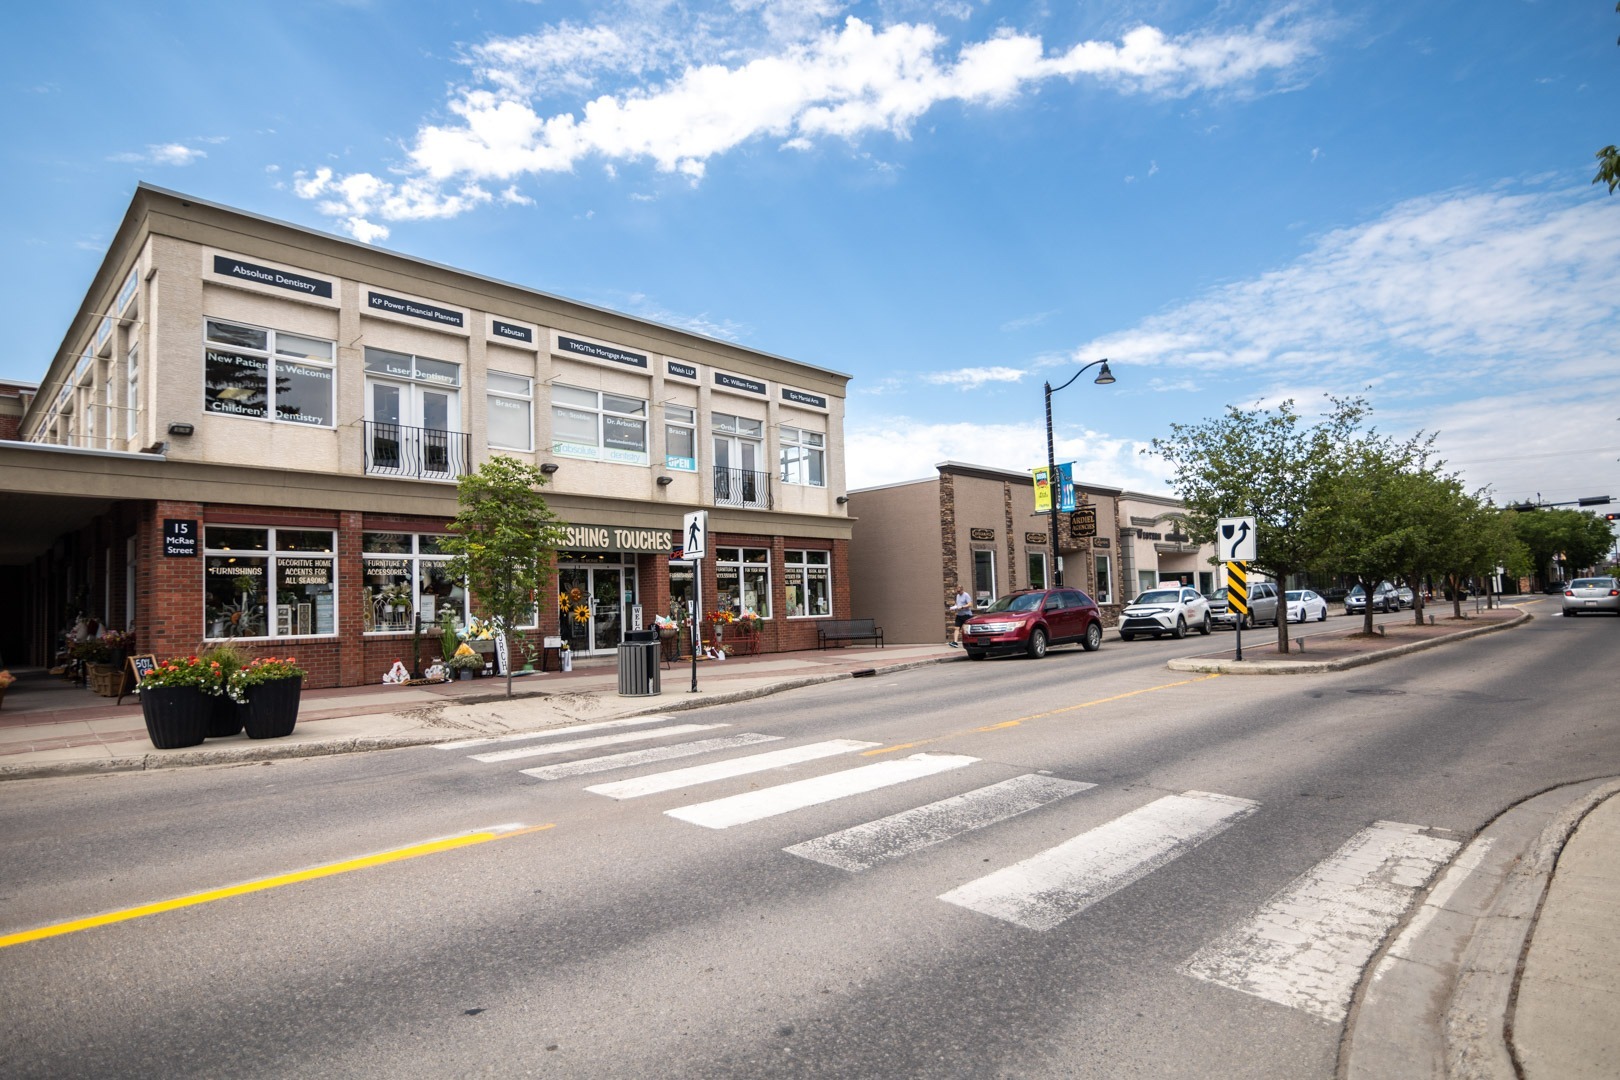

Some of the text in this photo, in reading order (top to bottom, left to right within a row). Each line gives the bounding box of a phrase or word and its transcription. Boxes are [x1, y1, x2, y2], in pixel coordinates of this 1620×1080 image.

[233, 265, 316, 292] Absolute Dentistry
[372, 297, 460, 323] KP Power Financial Planners
[500, 326, 525, 338] Fabutan
[569, 341, 639, 363] TMG/The Mortgage Avenue
[207, 352, 331, 380] New Patients Welcome
[670, 365, 685, 374] Walsh
[386, 364, 454, 384] Laser Dentistry
[495, 399, 521, 409] Braces
[212, 401, 323, 425] Children's Dentistry
[616, 419, 641, 429] Arbuckle
[562, 443, 640, 462] absolute dentistry
[668, 457, 690, 469] OPEN
[1071, 515, 1095, 525] ARDIEL
[175, 523, 188, 534] 15
[166, 536, 195, 545] McRae
[614, 529, 672, 550] TOUCHES
[167, 545, 194, 554] Street
[669, 549, 684, 559] OPE
[277, 558, 332, 568] DECORITIVE HOME
[367, 560, 400, 568] FURNITURE
[211, 567, 262, 576] FURNISHINGS
[285, 568, 327, 576] ACCENTS FOR
[367, 568, 408, 576] ACCESSORIES
[285, 576, 327, 585] ALL SEASONS
[135, 658, 153, 668] 50%
